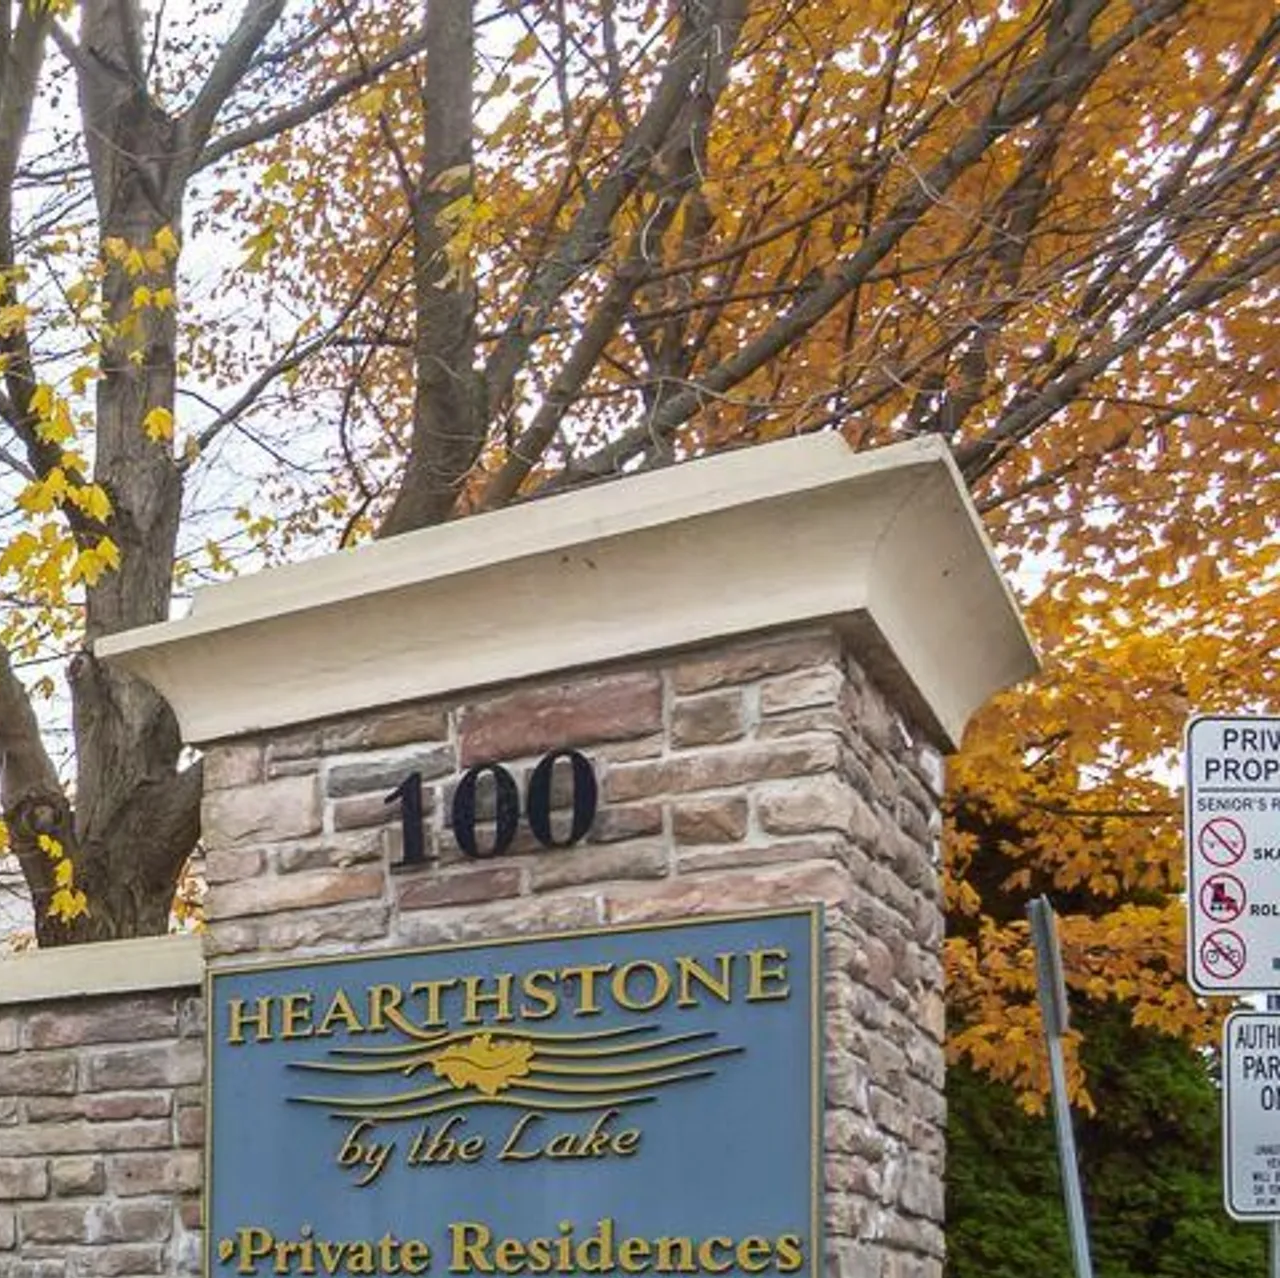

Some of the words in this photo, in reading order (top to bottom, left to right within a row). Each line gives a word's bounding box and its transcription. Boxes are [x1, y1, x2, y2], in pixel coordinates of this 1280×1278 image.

[384, 748, 598, 870] 100
[1204, 758, 1279, 782] PROP
[225, 945, 792, 1044] HEARTHSTONE
[337, 1120, 395, 1188] by
[408, 1113, 485, 1168] the
[496, 1110, 643, 1163] Lake
[237, 1223, 432, 1275] Private
[448, 1219, 805, 1275] Residences
